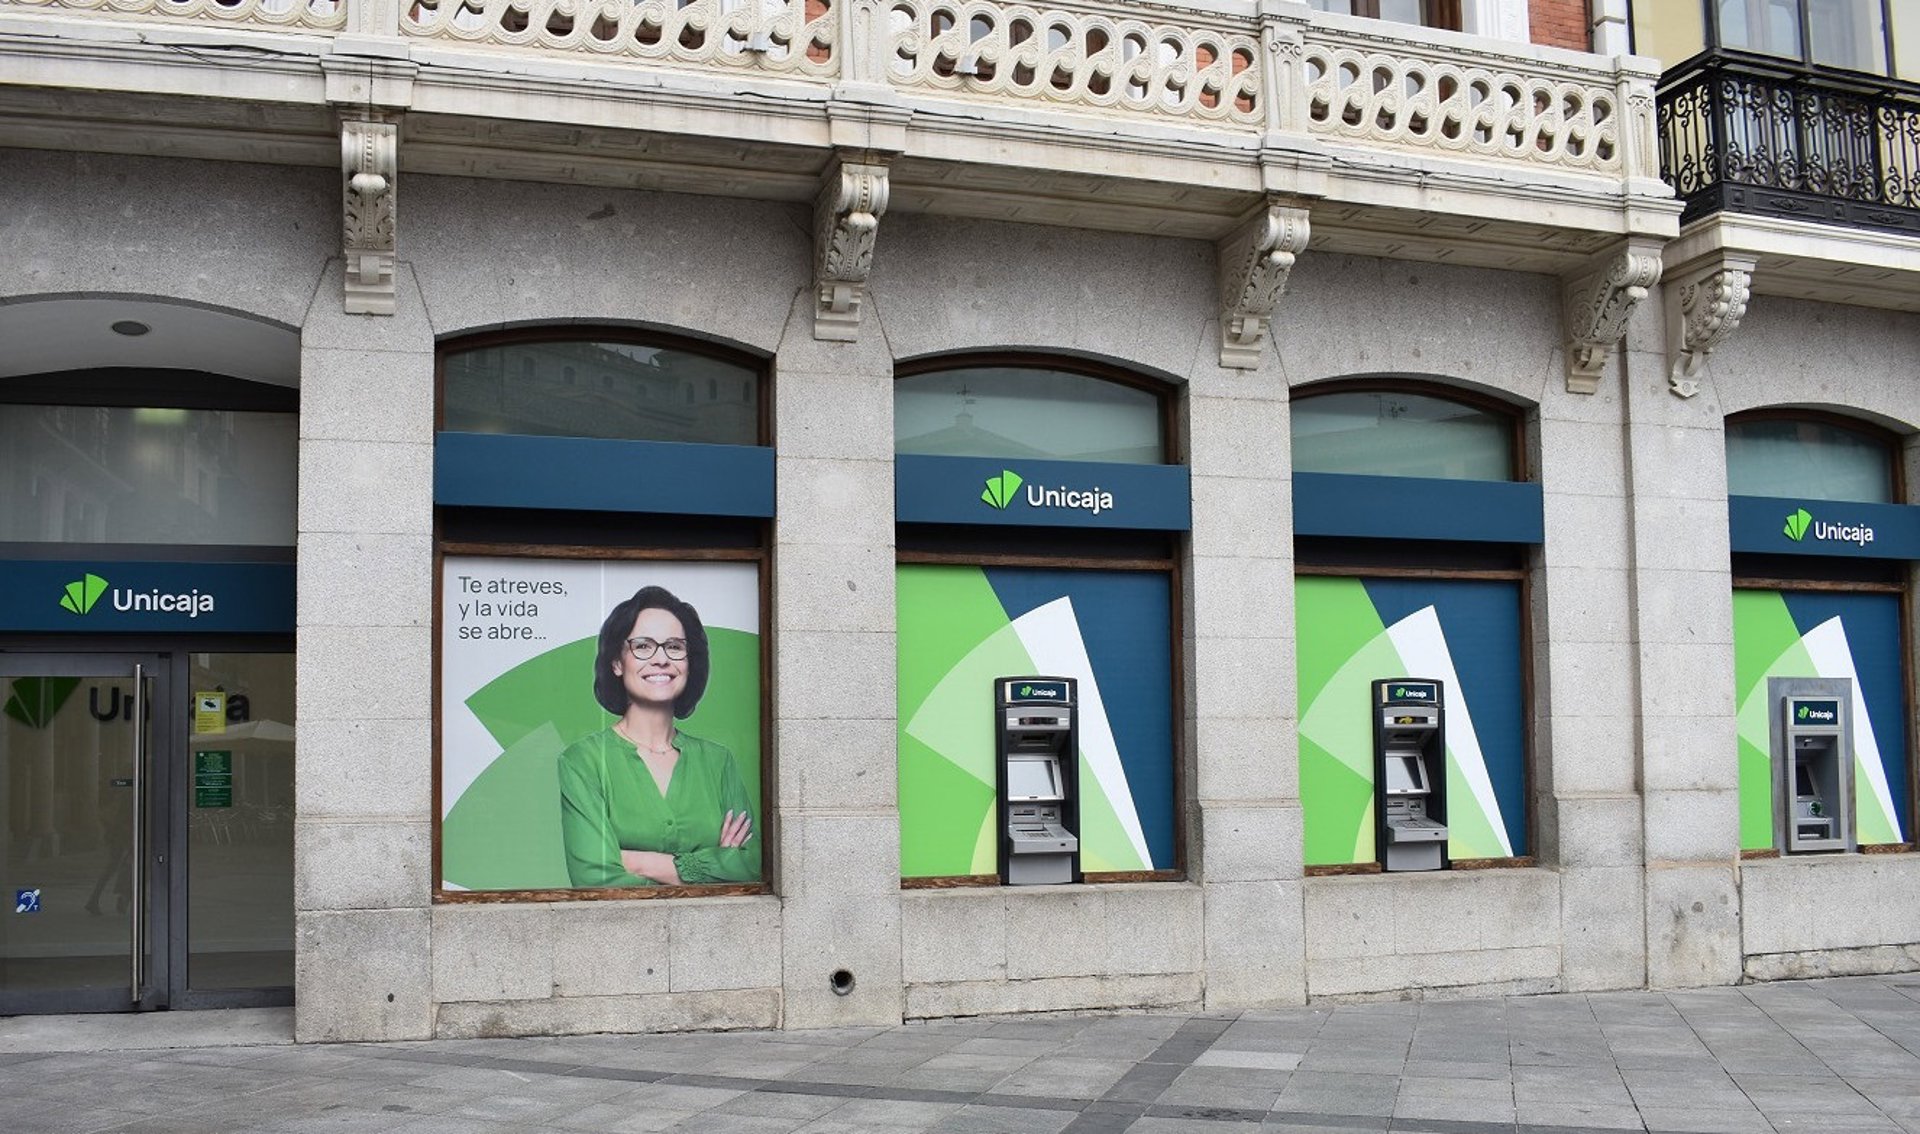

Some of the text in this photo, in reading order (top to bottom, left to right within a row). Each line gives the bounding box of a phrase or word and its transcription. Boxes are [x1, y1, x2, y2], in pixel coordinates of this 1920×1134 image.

[1027, 484, 1113, 515] Unicaja
[1814, 520, 1874, 547] Unicaja
[458, 575, 568, 597] Te atreves,
[113, 588, 214, 618] Unicaja
[458, 599, 538, 621] y la vida
[458, 623, 547, 640] se abre...
[1031, 689, 1057, 698] Unicaja
[1405, 690, 1427, 699] Unicaja
[1809, 710, 1834, 721] Unicaja
